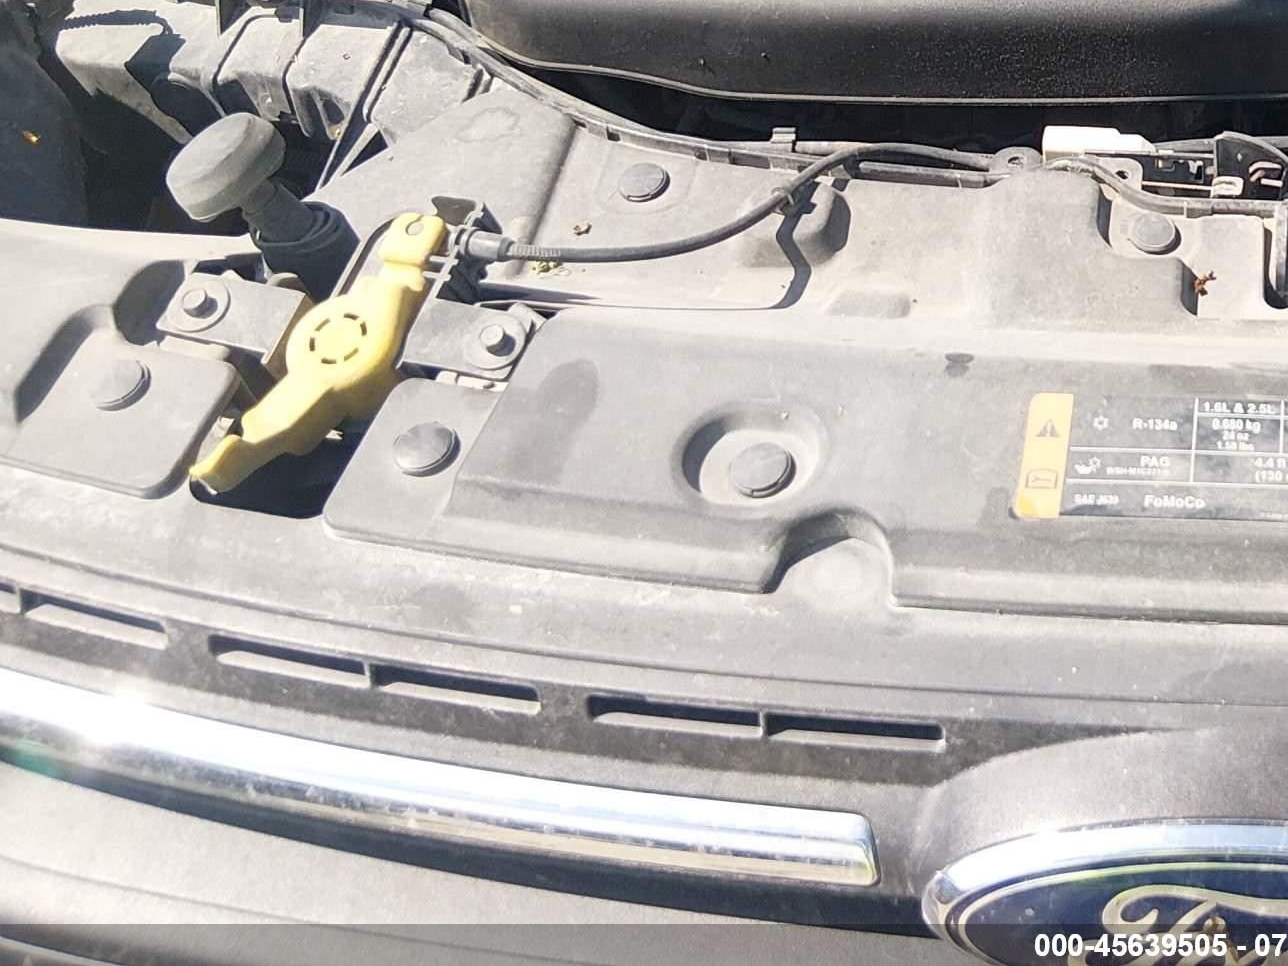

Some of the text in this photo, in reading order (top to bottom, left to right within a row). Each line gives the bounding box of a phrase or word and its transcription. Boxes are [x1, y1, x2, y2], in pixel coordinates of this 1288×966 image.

[1203, 401, 1276, 415] 1.6L & 2.5L
[1132, 417, 1178, 431] R-134a
[1212, 418, 1261, 434] 0.680 kg
[1140, 455, 1170, 467] PAG
[1254, 457, 1275, 468] 4.4
[1255, 471, 1283, 483] (130
[1144, 494, 1206, 509] FoMoCo
